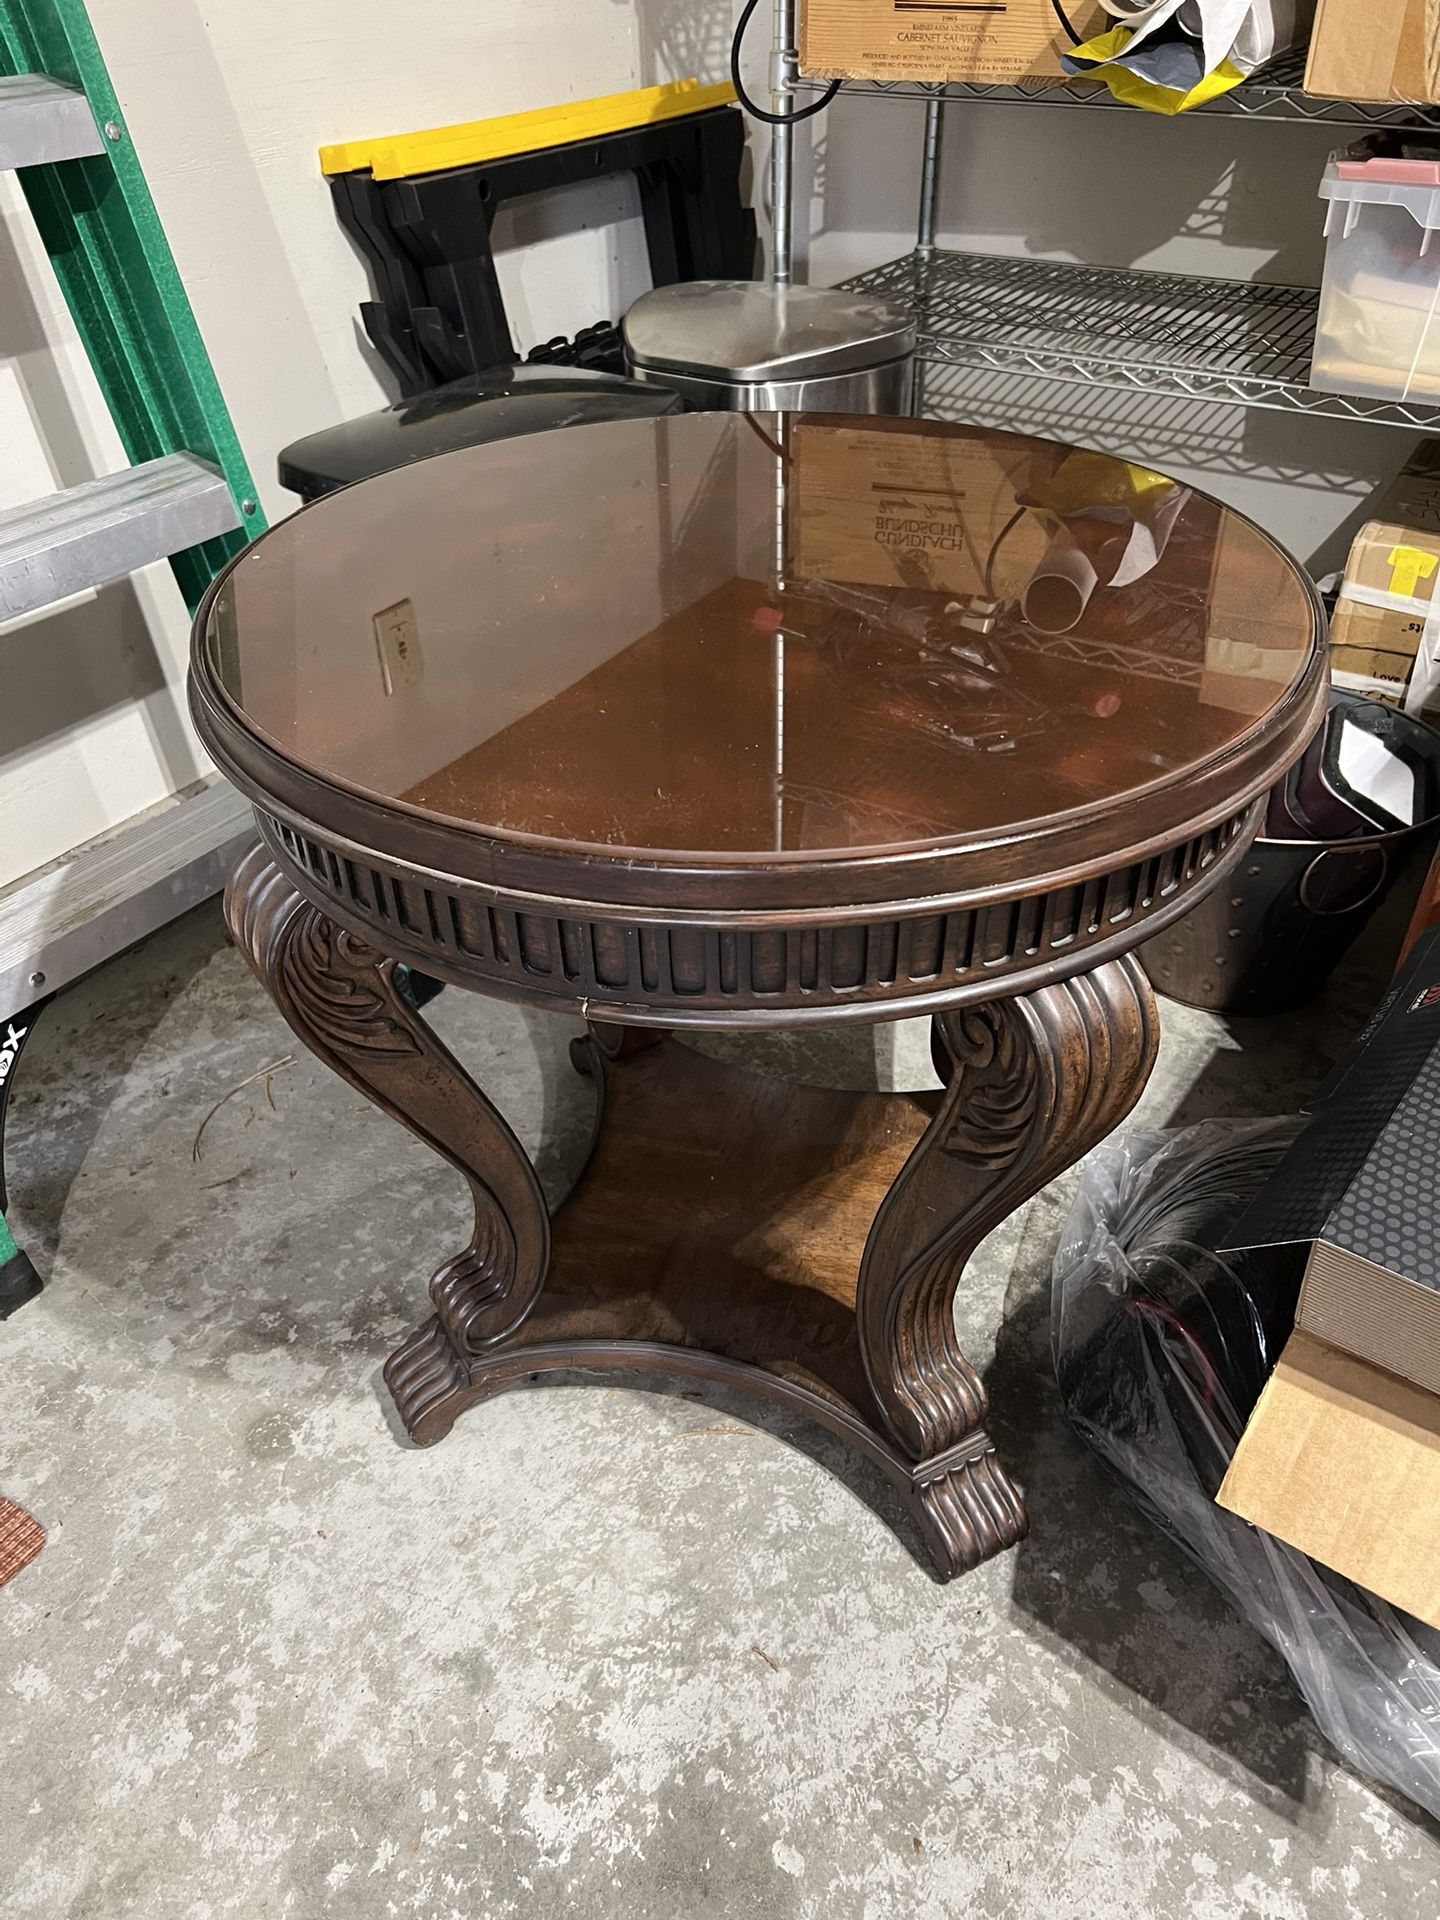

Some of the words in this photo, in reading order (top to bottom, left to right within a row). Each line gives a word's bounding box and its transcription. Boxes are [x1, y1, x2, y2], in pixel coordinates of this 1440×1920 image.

[896, 32, 941, 43] CABERNET
[943, 33, 998, 44] SAUVIGNON
[950, 45, 977, 53] VALLEY
[862, 52, 889, 60] PRODUCED
[1373, 671, 1401, 683] Love
